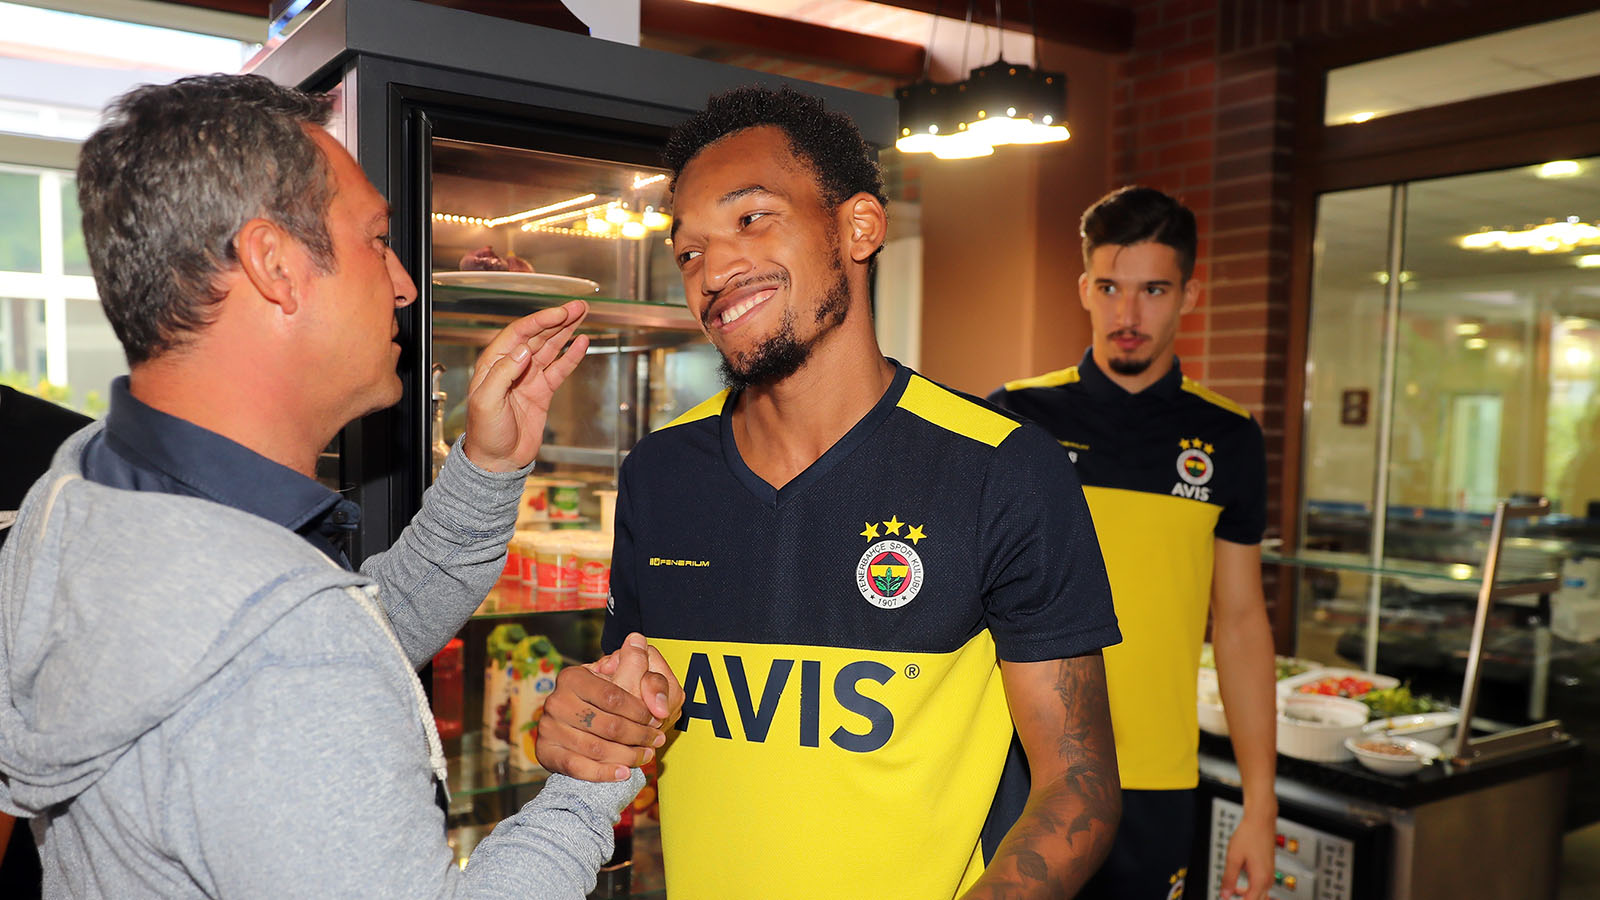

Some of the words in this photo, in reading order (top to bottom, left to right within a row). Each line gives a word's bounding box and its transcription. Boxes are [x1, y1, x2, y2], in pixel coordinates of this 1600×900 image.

[1171, 482, 1210, 502] AVIS
[889, 541, 913, 558] SPOR
[660, 559, 710, 567] FENERIUM
[878, 598, 897, 607] 1907
[674, 652, 897, 753] AVIS
